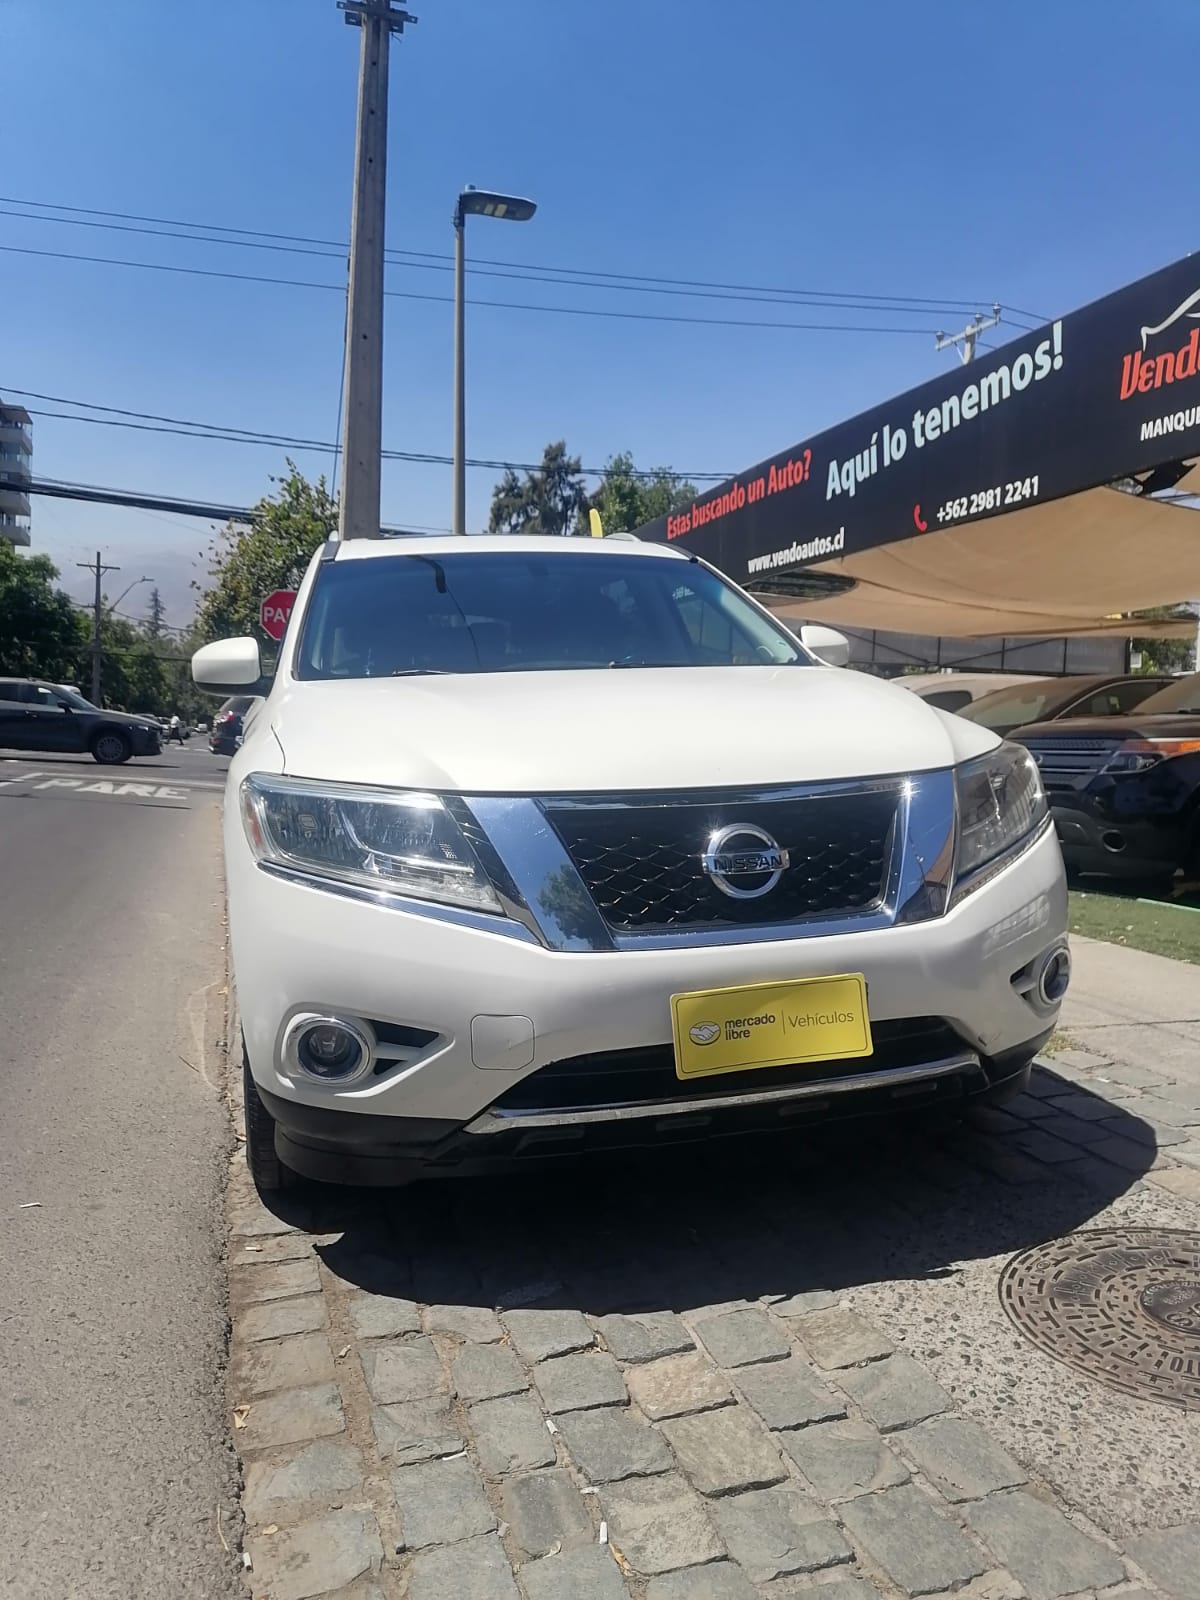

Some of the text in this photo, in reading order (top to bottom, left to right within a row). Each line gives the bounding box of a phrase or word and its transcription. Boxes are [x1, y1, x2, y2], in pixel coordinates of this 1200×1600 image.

[826, 320, 1064, 500] Aquí lo tenemos!
[667, 449, 812, 540] Estas buscando un Auto?
[936, 475, 1039, 522] +562 2981 2241
[748, 527, 845, 573] www.vendoautos.cl
[32, 778, 191, 800] PARE
[713, 854, 783, 871] NISSAN
[724, 1010, 855, 1031] mercado Vehículos
[725, 1027, 751, 1041] libre
